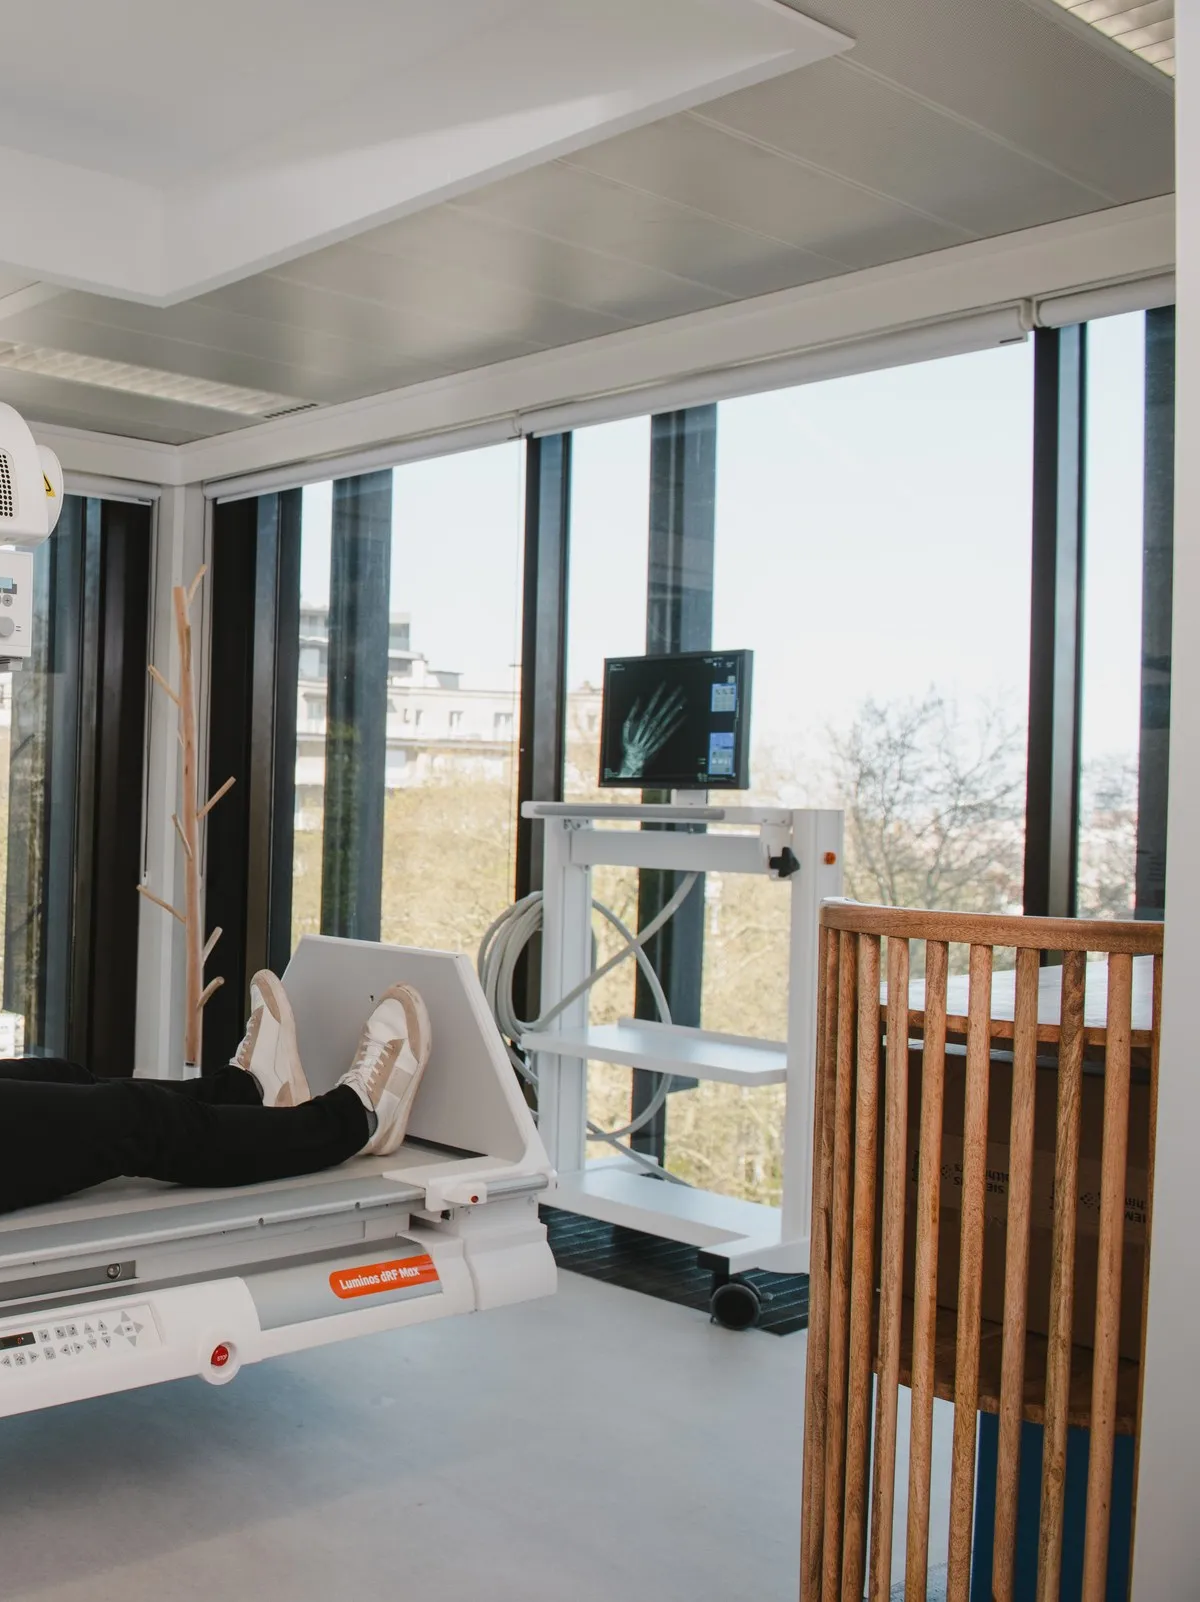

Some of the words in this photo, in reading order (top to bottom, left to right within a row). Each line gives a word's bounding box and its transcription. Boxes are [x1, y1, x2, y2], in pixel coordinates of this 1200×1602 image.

[339, 1274, 380, 1290] Luminos
[380, 1269, 398, 1283] dRF
[398, 1266, 420, 1279] Max
[216, 1353, 228, 1362] STOP
